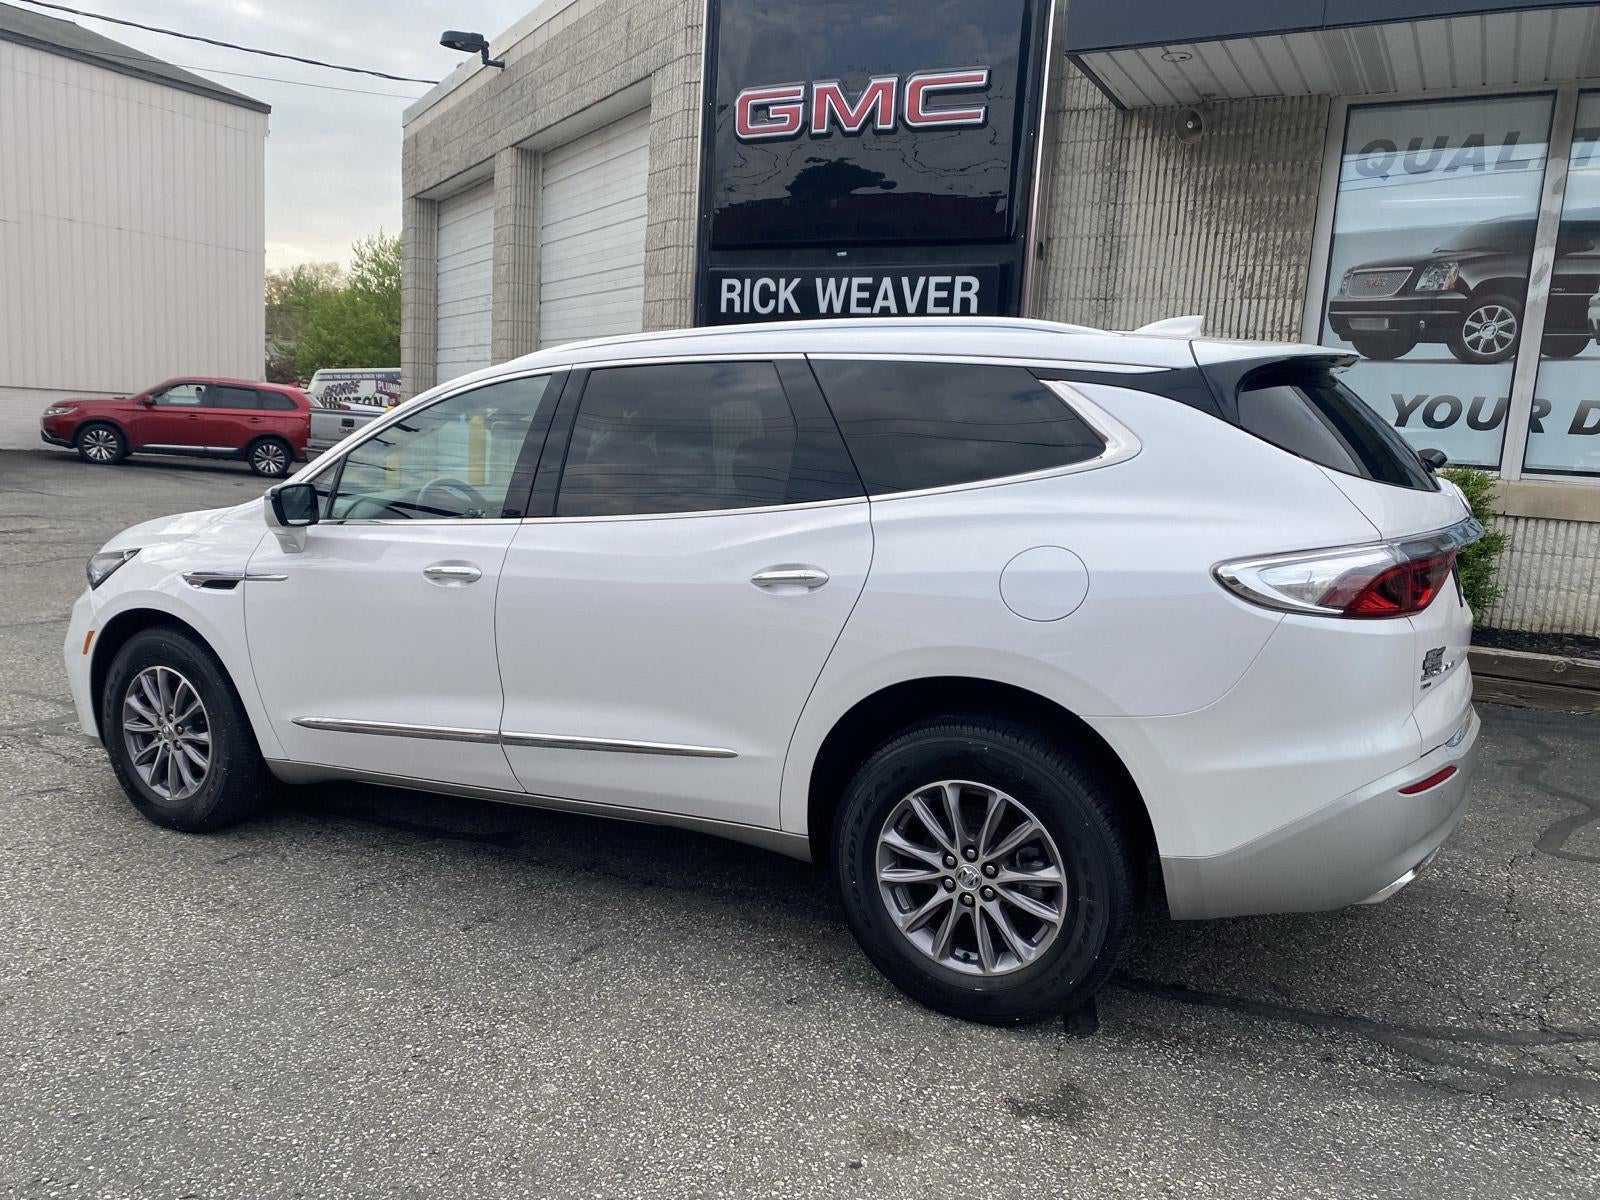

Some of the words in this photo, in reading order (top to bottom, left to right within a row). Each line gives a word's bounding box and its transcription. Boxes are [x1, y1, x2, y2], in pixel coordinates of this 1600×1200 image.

[735, 68, 990, 141] GMC
[720, 277, 802, 314] RICK
[815, 275, 980, 314] WEAVER
[323, 380, 361, 397] GEORGE
[1391, 394, 1552, 433] YOUR
